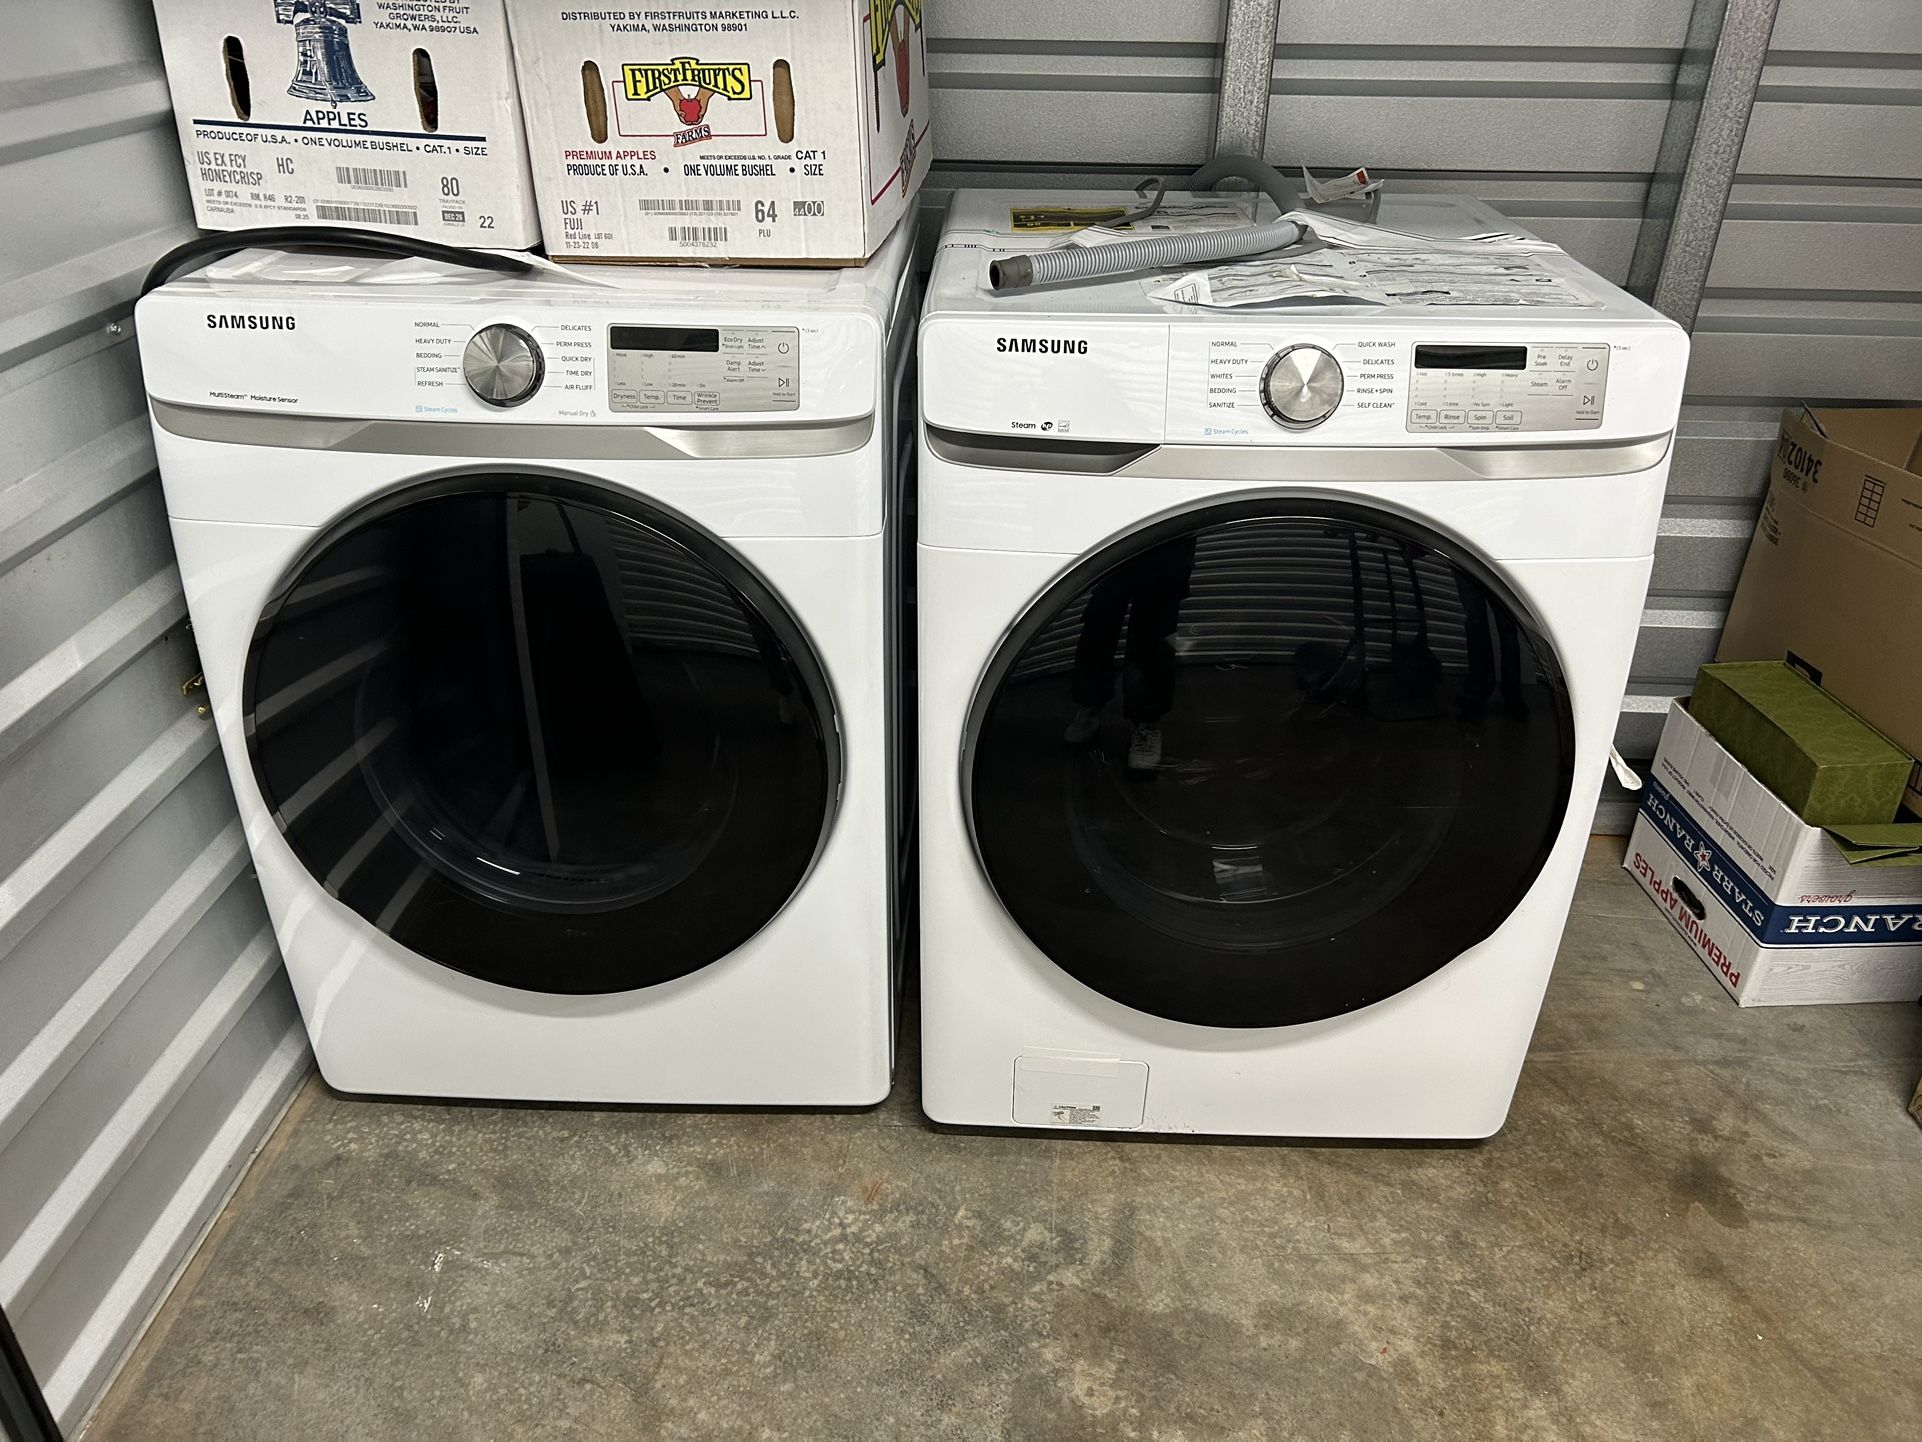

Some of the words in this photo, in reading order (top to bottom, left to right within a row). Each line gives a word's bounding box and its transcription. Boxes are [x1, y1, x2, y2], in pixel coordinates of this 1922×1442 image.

[377, 2, 440, 13] WASHINGTON
[442, 6, 470, 14] FRUIT
[388, 12, 439, 24] GROWERS,
[441, 15, 461, 24] LLC.
[561, 11, 626, 20] DISTRIBUTED
[628, 11, 642, 20] BY
[644, 11, 707, 20] FIRSTFRUITS
[710, 10, 768, 20] MARKETING
[772, 10, 800, 19] L.L.C.
[373, 21, 411, 32] YAKIMA,
[412, 23, 427, 32] WA
[428, 24, 456, 33] 98907
[459, 26, 479, 34] USA
[610, 24, 650, 34] YAKIMA,
[652, 24, 718, 32] WASHINGTON
[721, 23, 748, 32] 98901
[303, 109, 368, 128] APPLES
[674, 126, 711, 144] FARMS
[196, 130, 245, 142] PRODUCE
[245, 133, 260, 142] OF
[261, 134, 291, 144] U.S.A.
[301, 136, 324, 146] ONE
[326, 138, 369, 150] VOLUME
[370, 141, 413, 152] BUSHEL
[464, 146, 488, 156] SIZE
[564, 150, 612, 160] PREMIUM
[615, 150, 656, 160] APPLES
[796, 150, 818, 160] CAT
[820, 150, 826, 160] 1
[197, 150, 212, 166] US
[214, 152, 227, 167] EX
[228, 153, 246, 168] FCY
[276, 157, 294, 174] HC
[566, 164, 606, 176] PRODUCE
[608, 164, 620, 176] OF
[622, 164, 648, 176] U.S.A.
[684, 164, 702, 176] ONE
[703, 164, 740, 176] VOLUME
[742, 164, 776, 176] BUSHEL
[804, 164, 824, 176] SIZE
[200, 168, 262, 186] HONEYCRISP
[441, 176, 460, 196] 80
[561, 200, 576, 216] US
[581, 200, 600, 216] #1
[754, 200, 778, 223] 64
[479, 216, 495, 229] 22
[564, 218, 583, 230] FUJI
[564, 232, 576, 240] Red
[578, 232, 592, 240] Line
[758, 228, 771, 238] PLU
[206, 314, 296, 330] SAMSUNG
[560, 324, 592, 332] DELICATES
[996, 337, 1088, 354] SAMSUNG
[748, 360, 764, 368] Adjust
[250, 394, 276, 402] Moisture
[278, 396, 299, 404] Sensor
[1011, 421, 1036, 429] Steam
[1646, 793, 1695, 852] RANCH
[1633, 852, 1678, 910] APPLES
[1712, 864, 1764, 927] STARR
[1798, 890, 1856, 904] growers
[1678, 909, 1741, 988] PREMIUM
